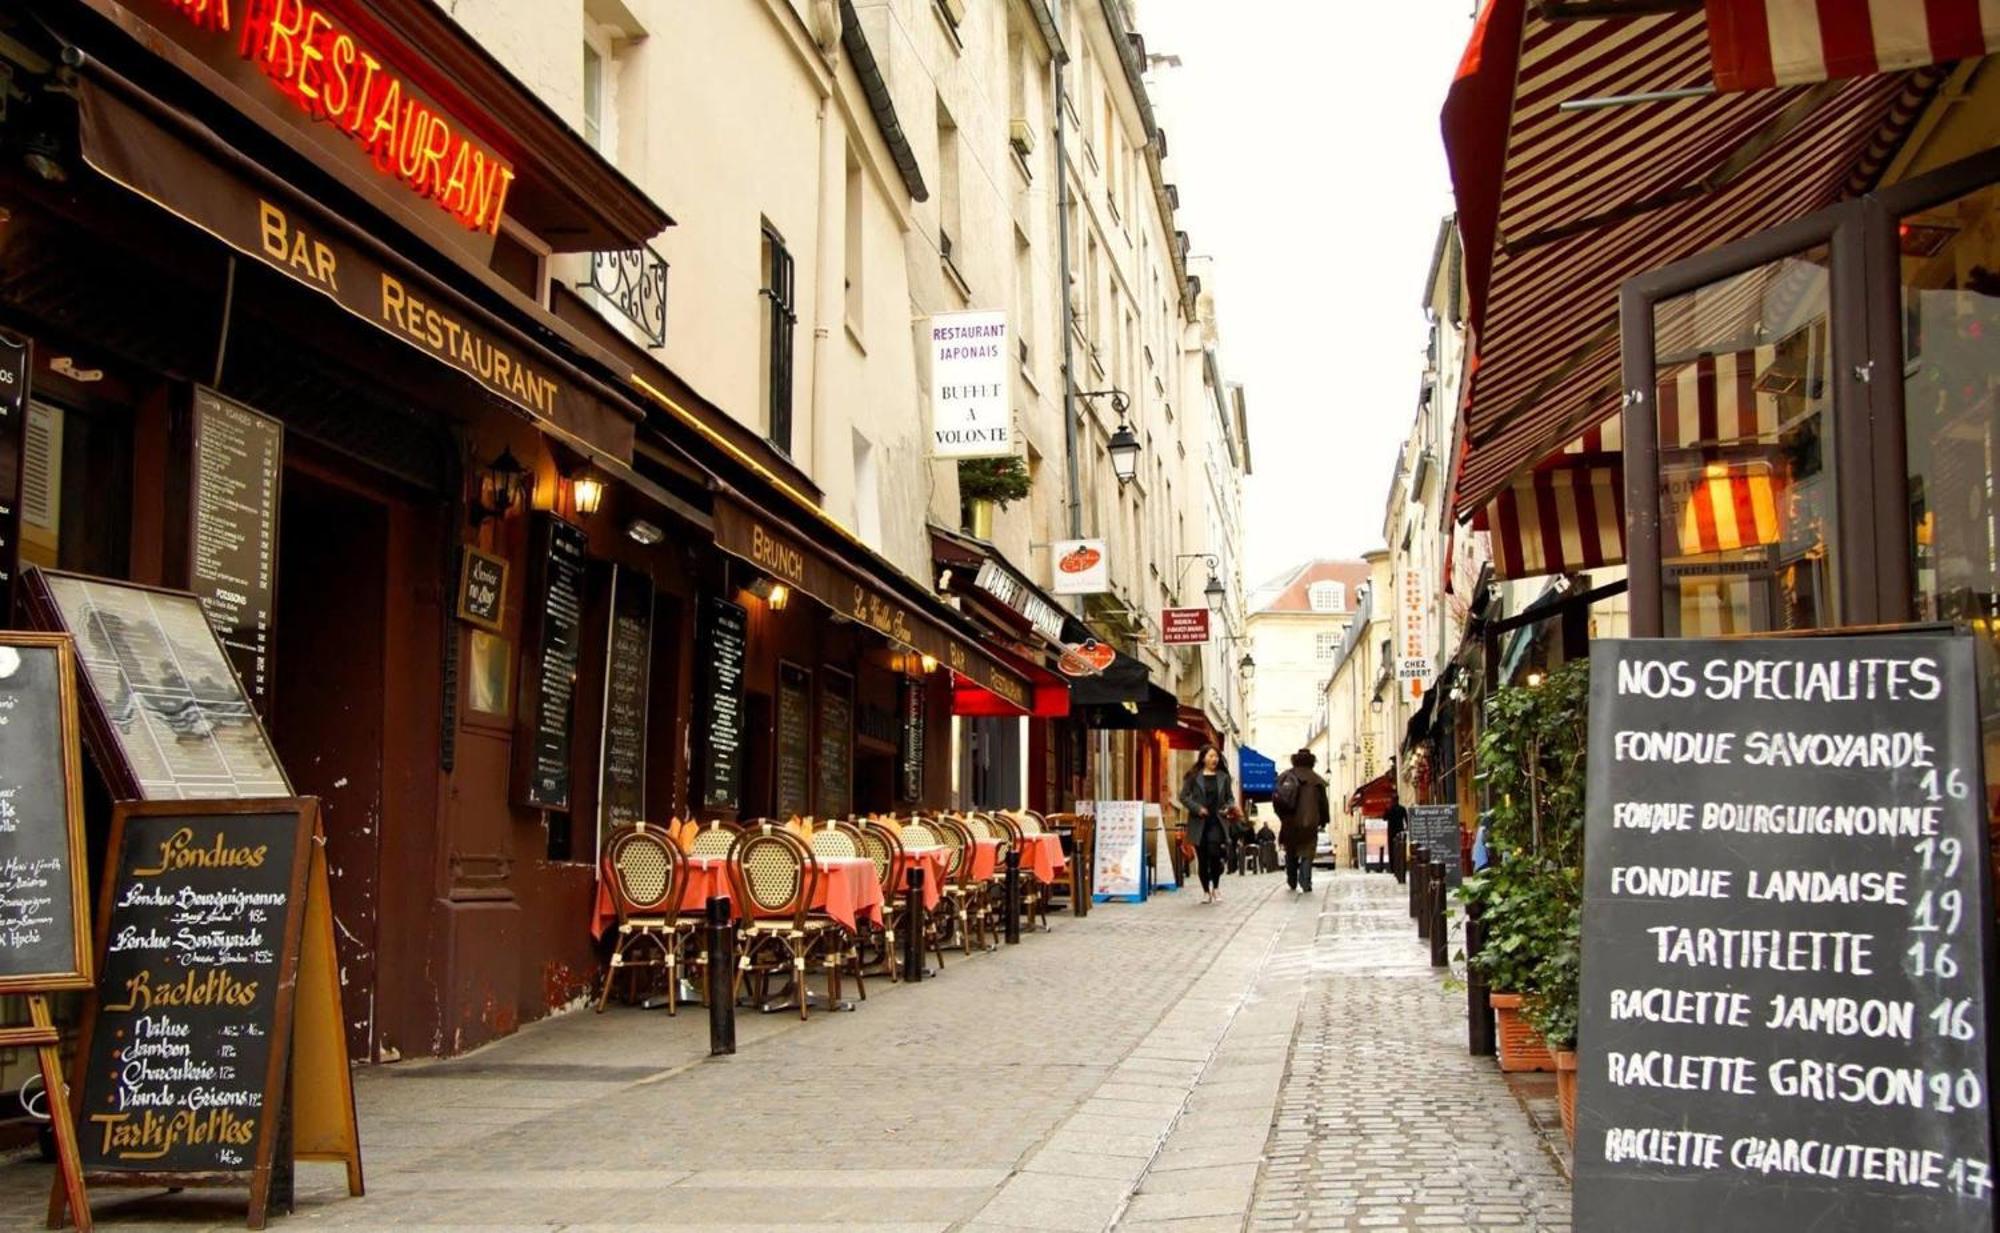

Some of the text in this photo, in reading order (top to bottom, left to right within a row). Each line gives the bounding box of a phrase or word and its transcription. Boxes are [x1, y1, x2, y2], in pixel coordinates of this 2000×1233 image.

[268, 0, 514, 235] RESTAURANT
[260, 200, 558, 416] BAR RESTAURANT
[933, 324, 1005, 340] RESTAURANT
[940, 345, 999, 360] JAPONAIS
[941, 383, 1001, 400] BUFFET
[935, 427, 1007, 444] VOLONTE
[752, 525, 804, 582] BRUNCH
[1400, 669, 1431, 678] ROBERT
[1404, 660, 1426, 669] CHEZ
[1618, 657, 1942, 701] NOS SPECIALITES
[1614, 731, 1937, 768] FONDUE SAVOYARDE
[1920, 768, 1969, 800] 16
[1613, 802, 1944, 837] FONDUE BOURGUIGNONNE
[133, 827, 268, 876] Fondues
[1913, 837, 1962, 878] 19
[118, 883, 287, 915] Fondue Bourguignonne
[1611, 866, 1963, 935] FONDUE LANDAISE 19
[110, 925, 172, 951] Fondue
[1646, 925, 1959, 979] TARTIFLETTE 16
[104, 969, 258, 1011] Raclettes
[135, 1015, 191, 1037] Nature
[1609, 987, 1975, 1040] RACLETTE JAMBON 16
[121, 1037, 190, 1062] Jambon
[122, 1058, 216, 1090] Charcuterie
[1608, 1051, 1983, 1113] RACLETTE GRISON 20
[118, 1085, 175, 1111] Viande
[187, 1086, 247, 1111] Grisons
[1605, 1126, 1993, 1198] RACLETTE CHARCUTERIE 17
